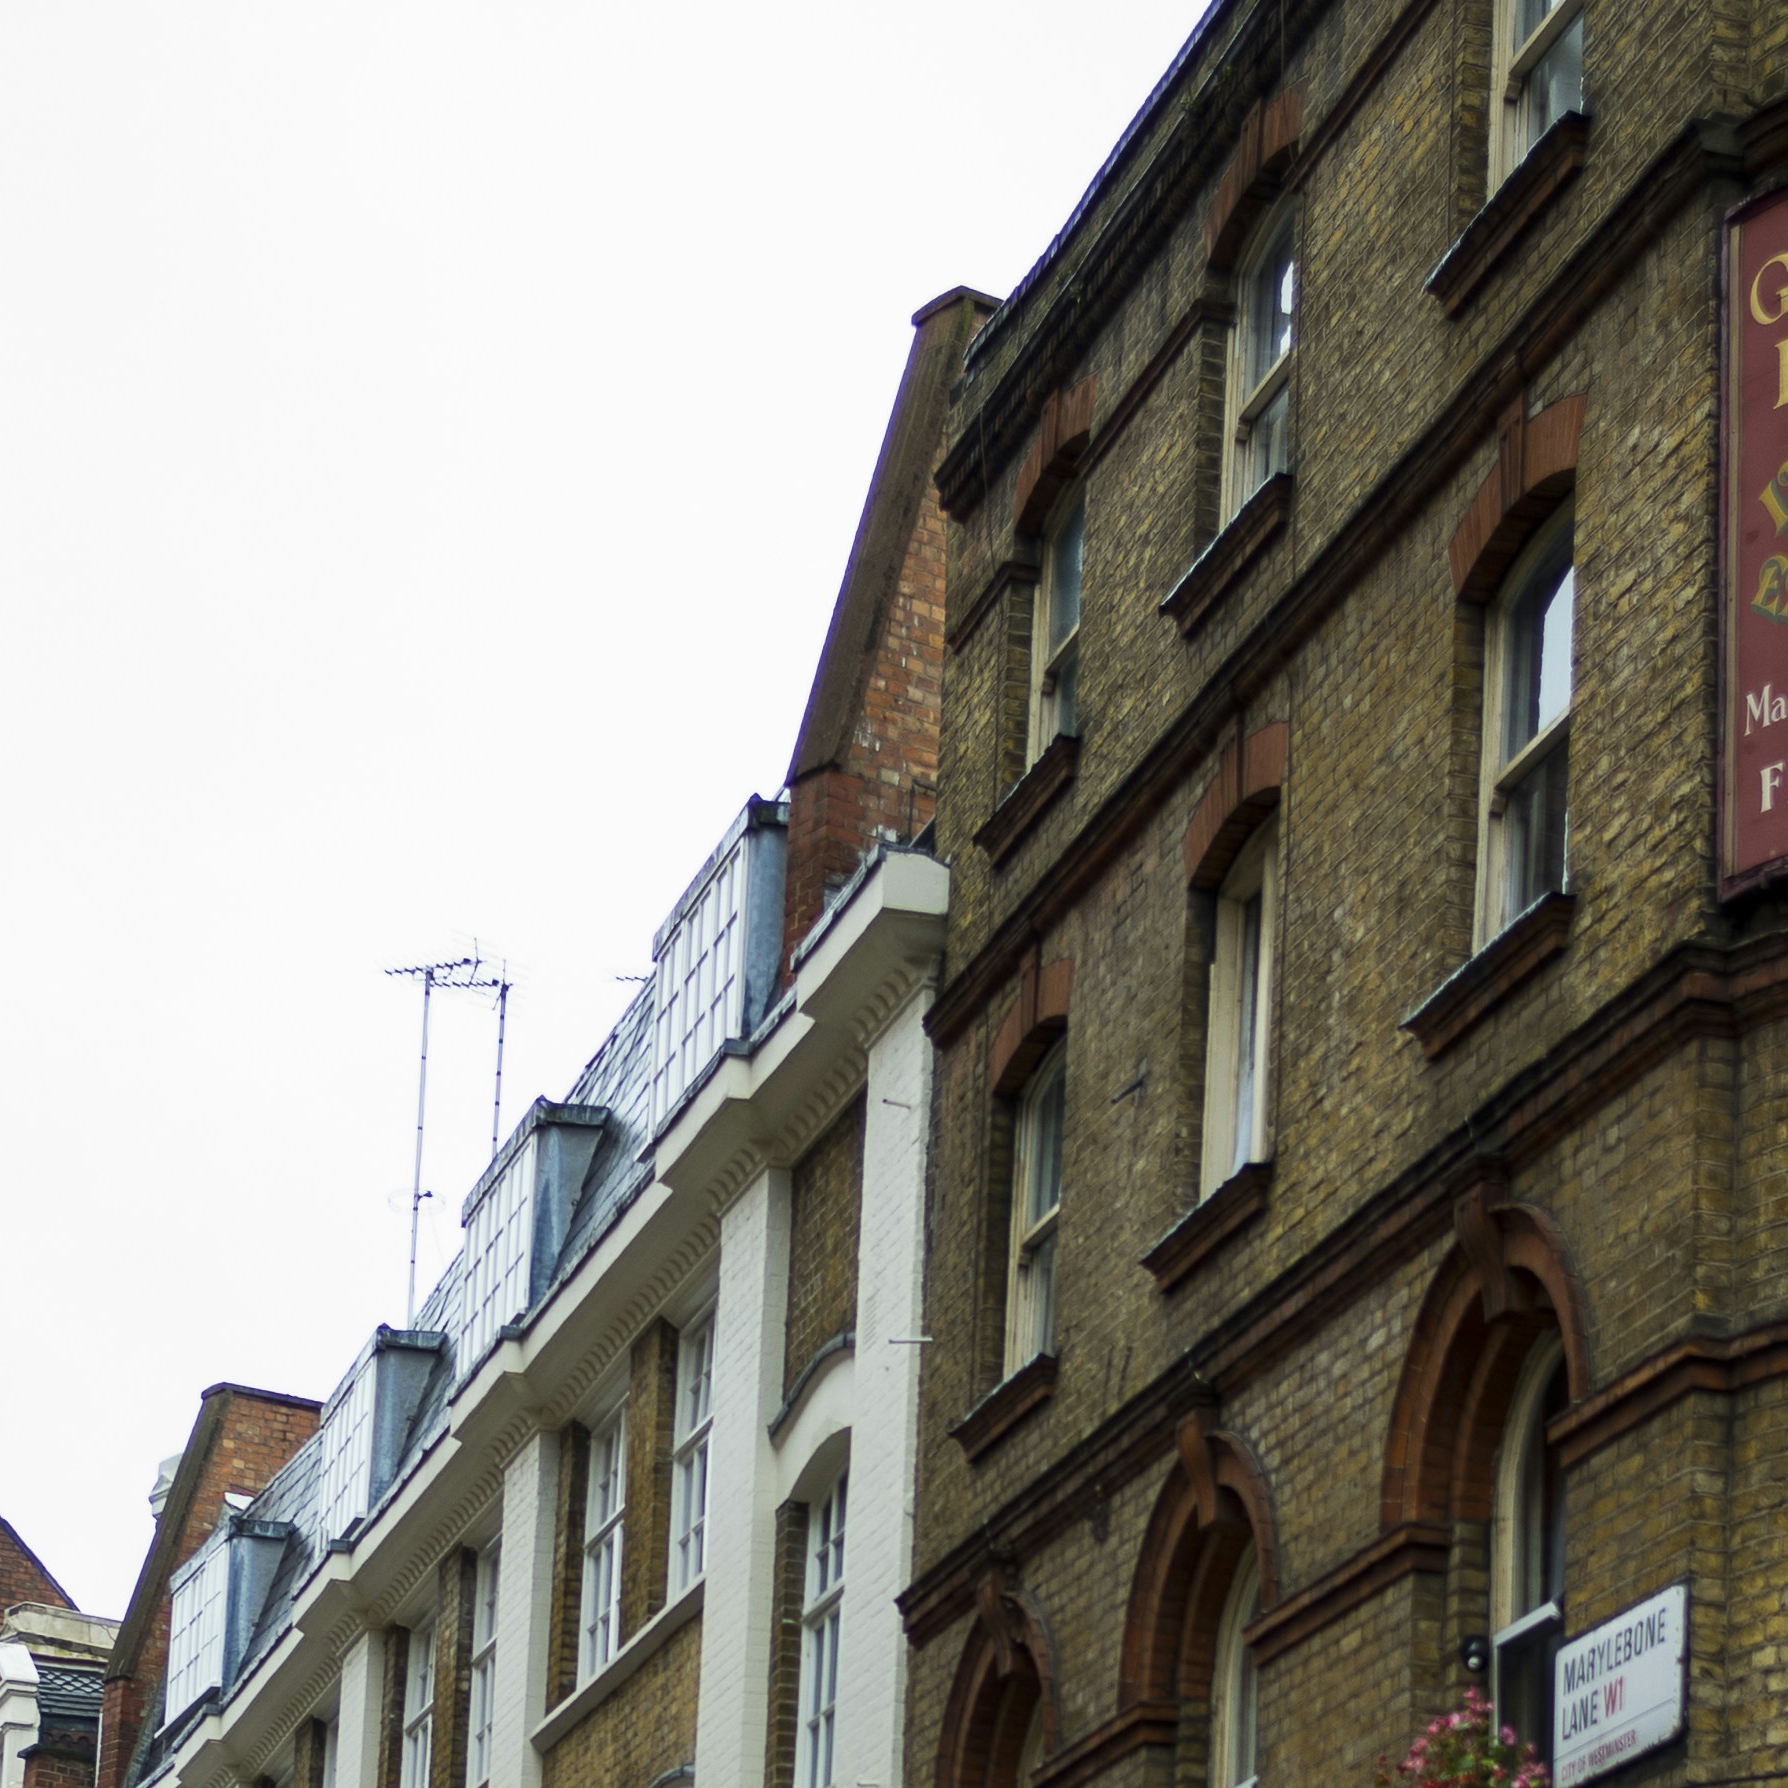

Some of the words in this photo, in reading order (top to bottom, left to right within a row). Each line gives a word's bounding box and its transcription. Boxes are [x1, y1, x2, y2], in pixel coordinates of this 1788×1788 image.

[1563, 1607, 1666, 1695] MARYLEBONE
[1563, 1690, 1598, 1740] LANE
[1603, 1676, 1624, 1718] W1
